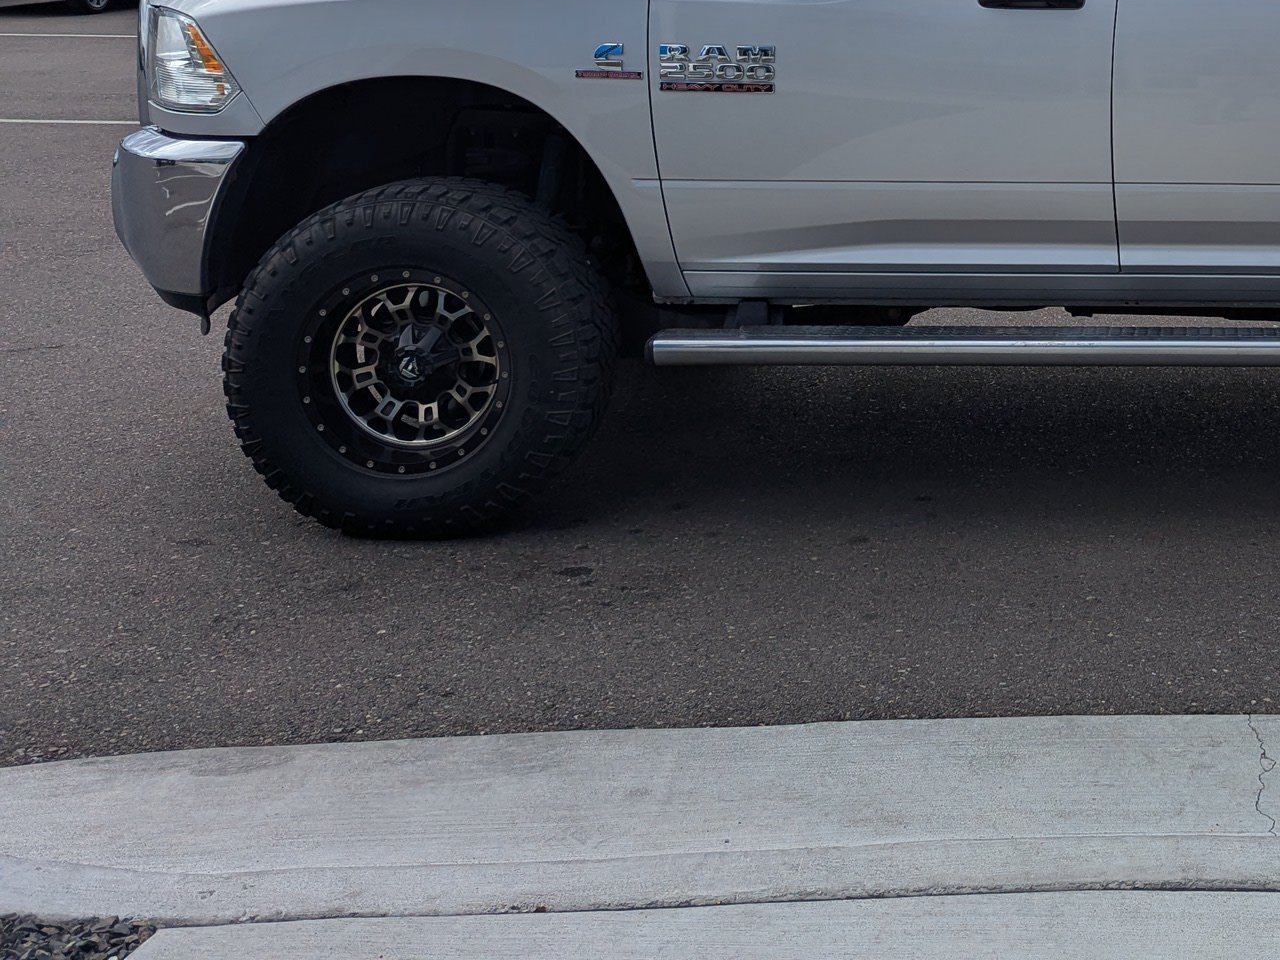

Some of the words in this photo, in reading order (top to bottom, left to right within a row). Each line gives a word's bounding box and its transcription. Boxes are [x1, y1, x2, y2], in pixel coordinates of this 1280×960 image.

[660, 43, 775, 62] RAM
[660, 63, 775, 80] 2500
[662, 83, 720, 91] HEAVY
[721, 83, 771, 92] DUTY
